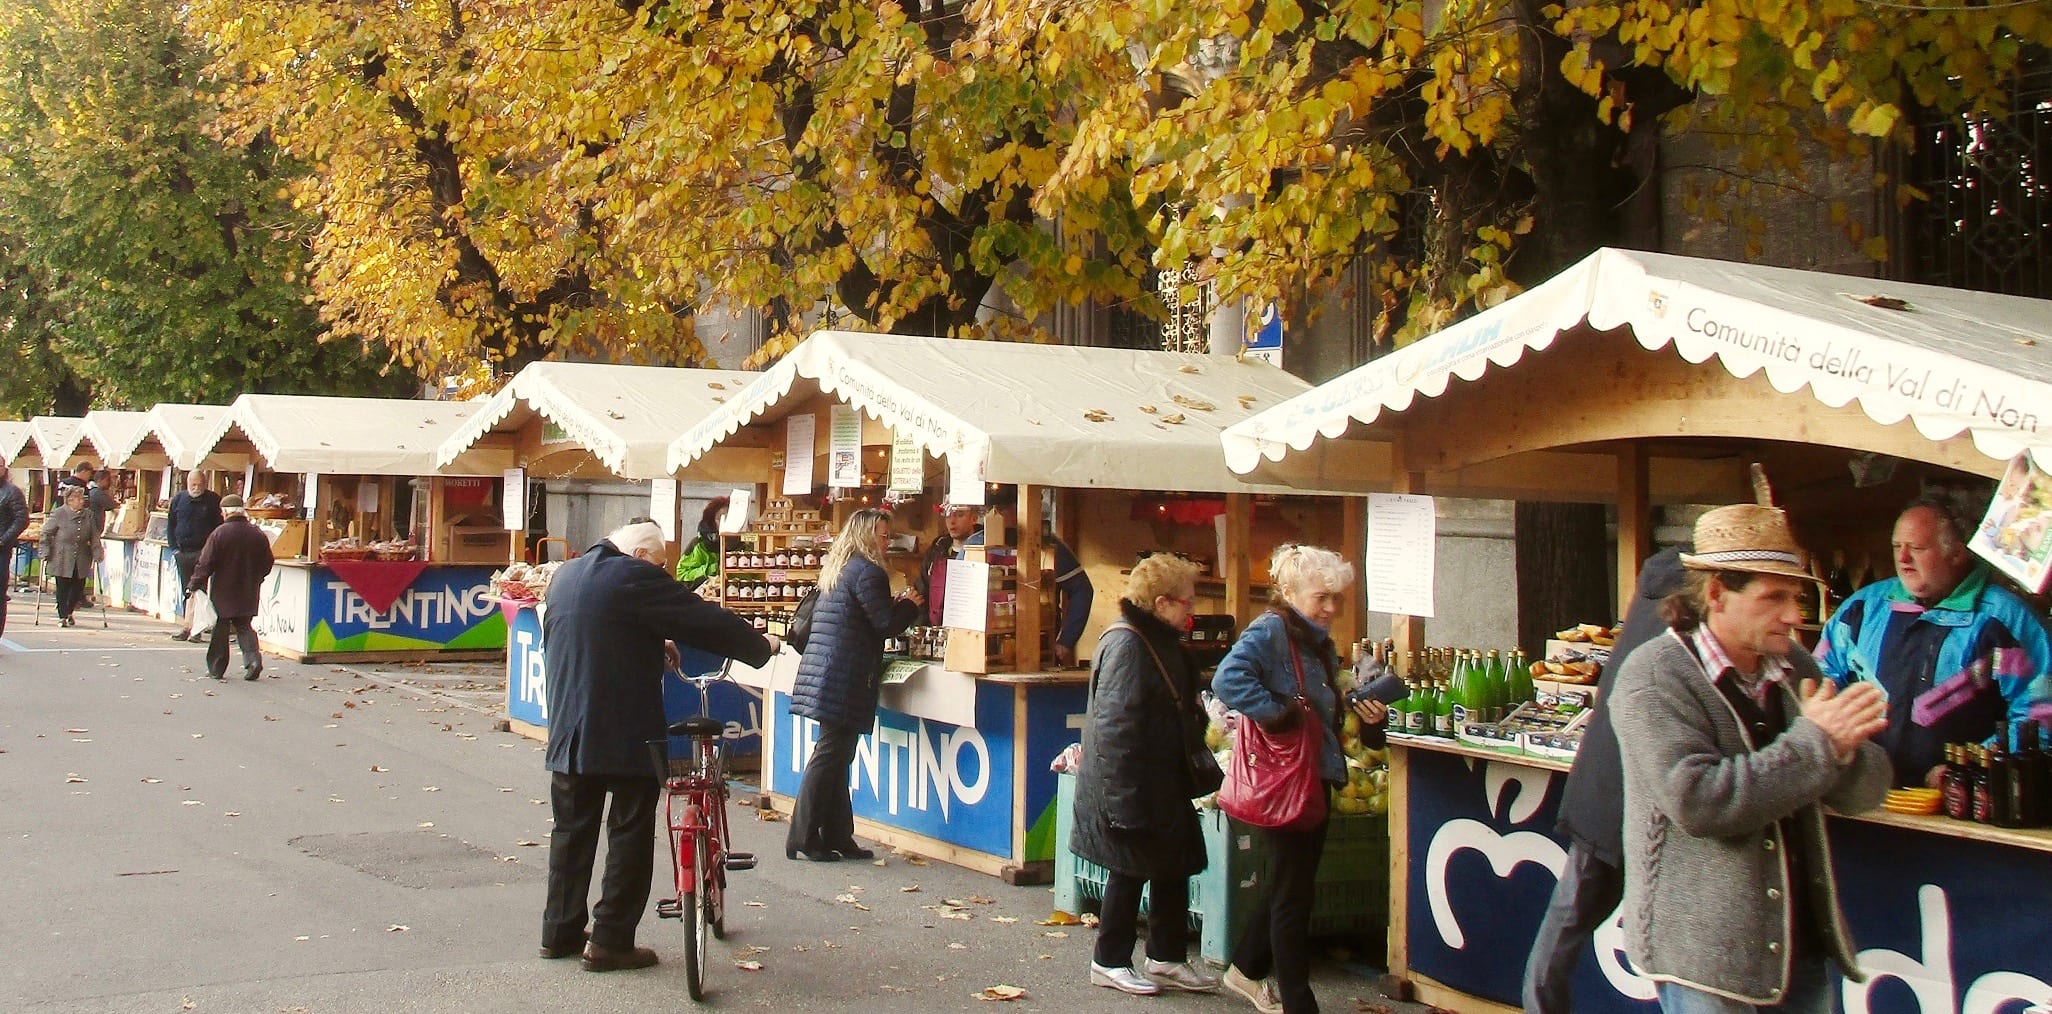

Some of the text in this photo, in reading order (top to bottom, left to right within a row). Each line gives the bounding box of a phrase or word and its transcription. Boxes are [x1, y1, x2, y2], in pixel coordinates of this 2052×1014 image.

[839, 366, 875, 400] Comunità
[876, 388, 897, 413] della
[900, 401, 915, 421] Val
[915, 410, 925, 428] di
[928, 417, 948, 439] Non
[1687, 307, 2039, 434] Comunità della Val di Non
